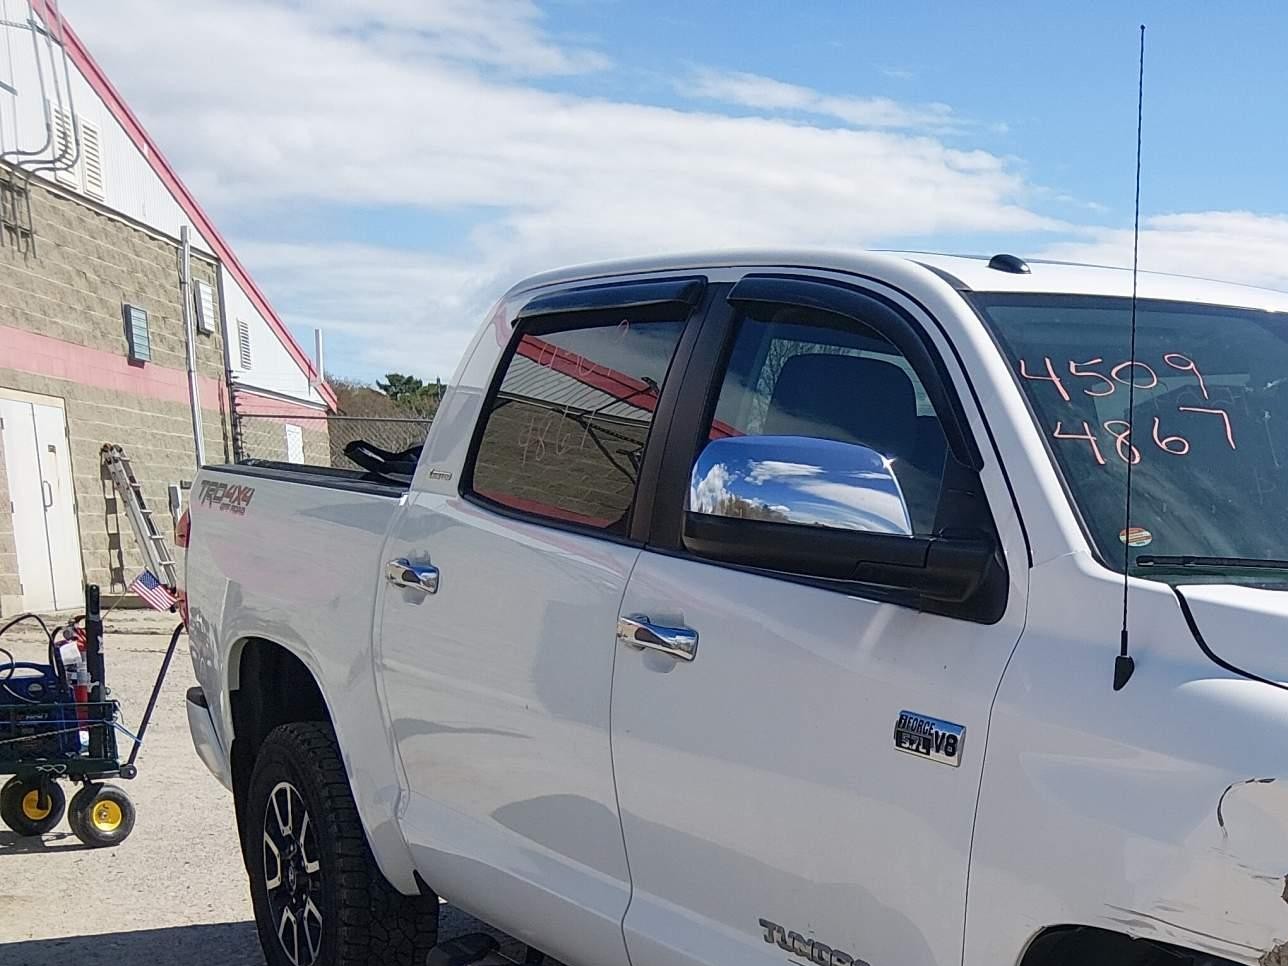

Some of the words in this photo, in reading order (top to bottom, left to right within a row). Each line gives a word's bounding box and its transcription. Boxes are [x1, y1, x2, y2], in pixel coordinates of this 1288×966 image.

[1019, 353, 1209, 401] 4509
[1053, 406, 1236, 465] 4867
[934, 729, 959, 757] V8
